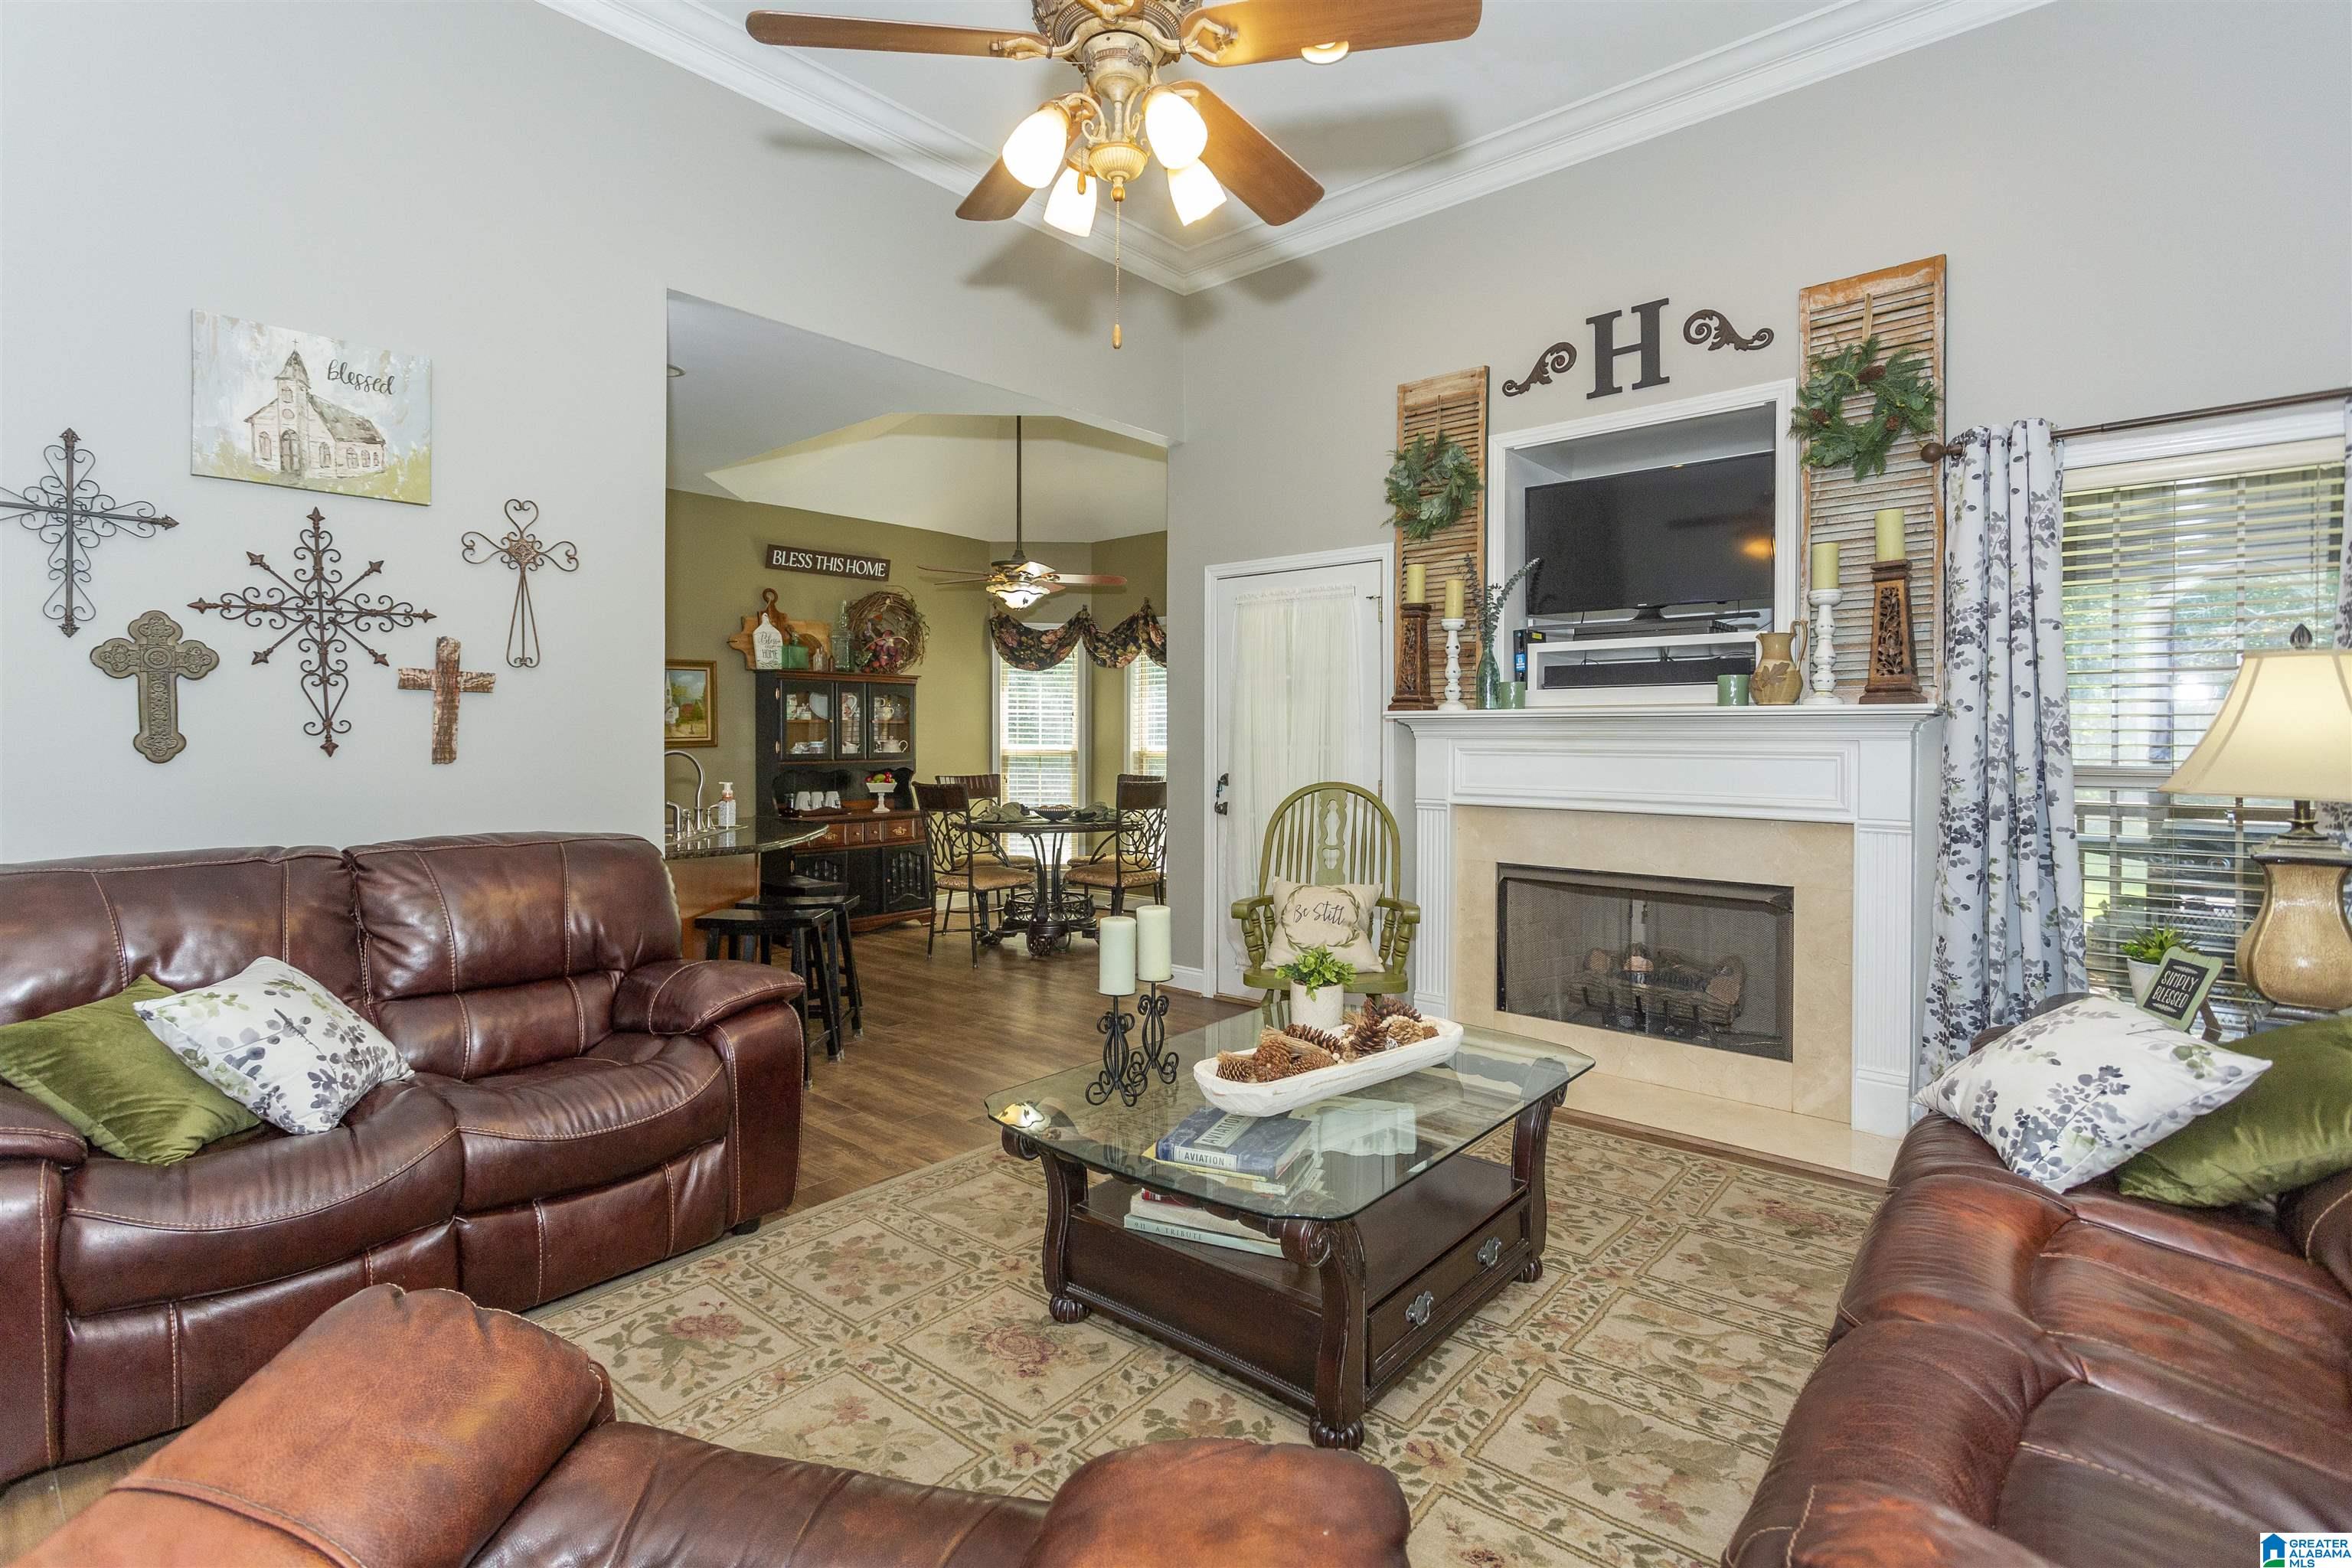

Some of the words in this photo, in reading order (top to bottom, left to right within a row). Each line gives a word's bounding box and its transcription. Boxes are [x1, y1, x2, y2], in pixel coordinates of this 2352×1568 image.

[328, 359, 396, 395] blessed
[773, 550, 813, 569] BLESS
[815, 555, 844, 572] THIS
[845, 559, 887, 577] HOME
[1293, 904, 1311, 923] Be
[1313, 900, 1345, 926] Still
[2161, 970, 2199, 992] SIMPLY
[2151, 985, 2190, 1008] BLESSED
[1201, 1114, 1244, 1144] AVIATION
[1184, 1152, 1224, 1166] AVIATION
[1165, 1227, 1202, 1240] TRIBUTE
